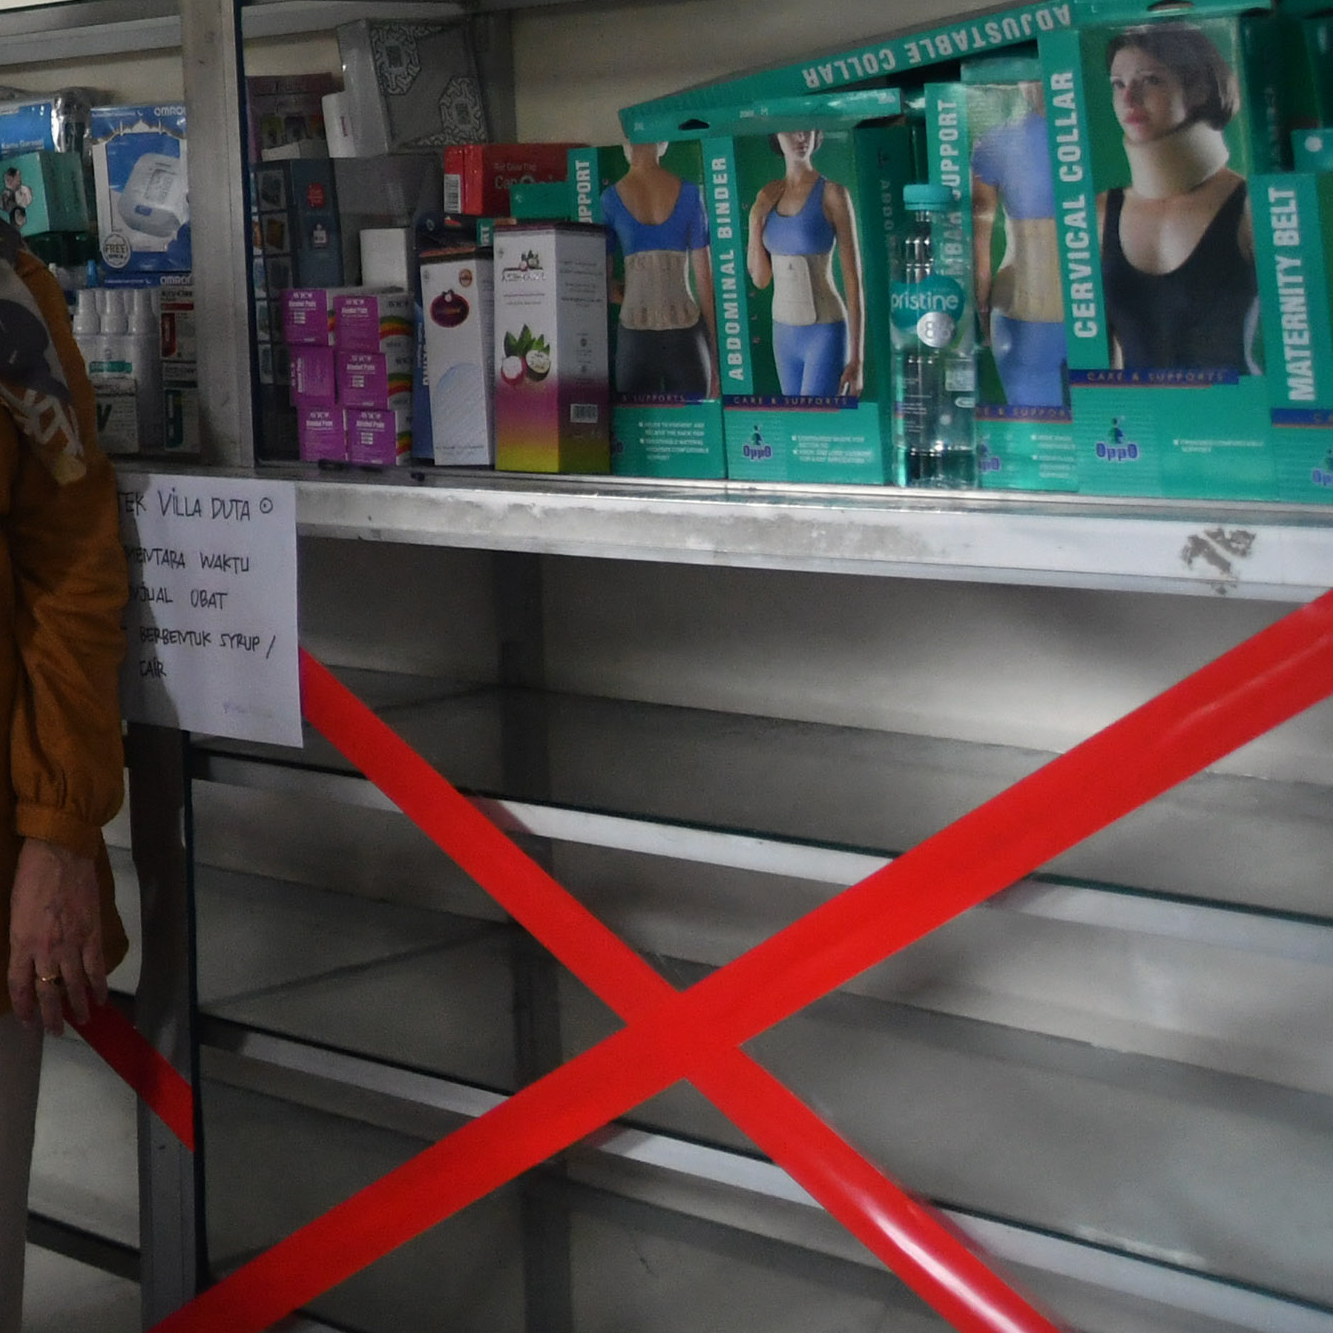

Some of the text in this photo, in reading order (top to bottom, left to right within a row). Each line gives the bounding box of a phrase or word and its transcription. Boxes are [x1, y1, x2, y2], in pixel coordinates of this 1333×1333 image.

[801, 2, 1073, 90] ADJUSTABLE COLLAR
[1050, 70, 1099, 338] CERVICAL COLLAR
[711, 156, 745, 382] ABDOMINAL BINDER
[891, 287, 960, 312] pristine
[1267, 186, 1317, 401] MATERNITY BELT
[1087, 371, 1123, 383] CARE
[158, 487, 251, 520] VILLA DUTA
[199, 552, 250, 575] WAKTU
[190, 589, 229, 610] OBAT
[140, 626, 213, 648] BERBENTUK
[219, 632, 261, 652] SYRUP
